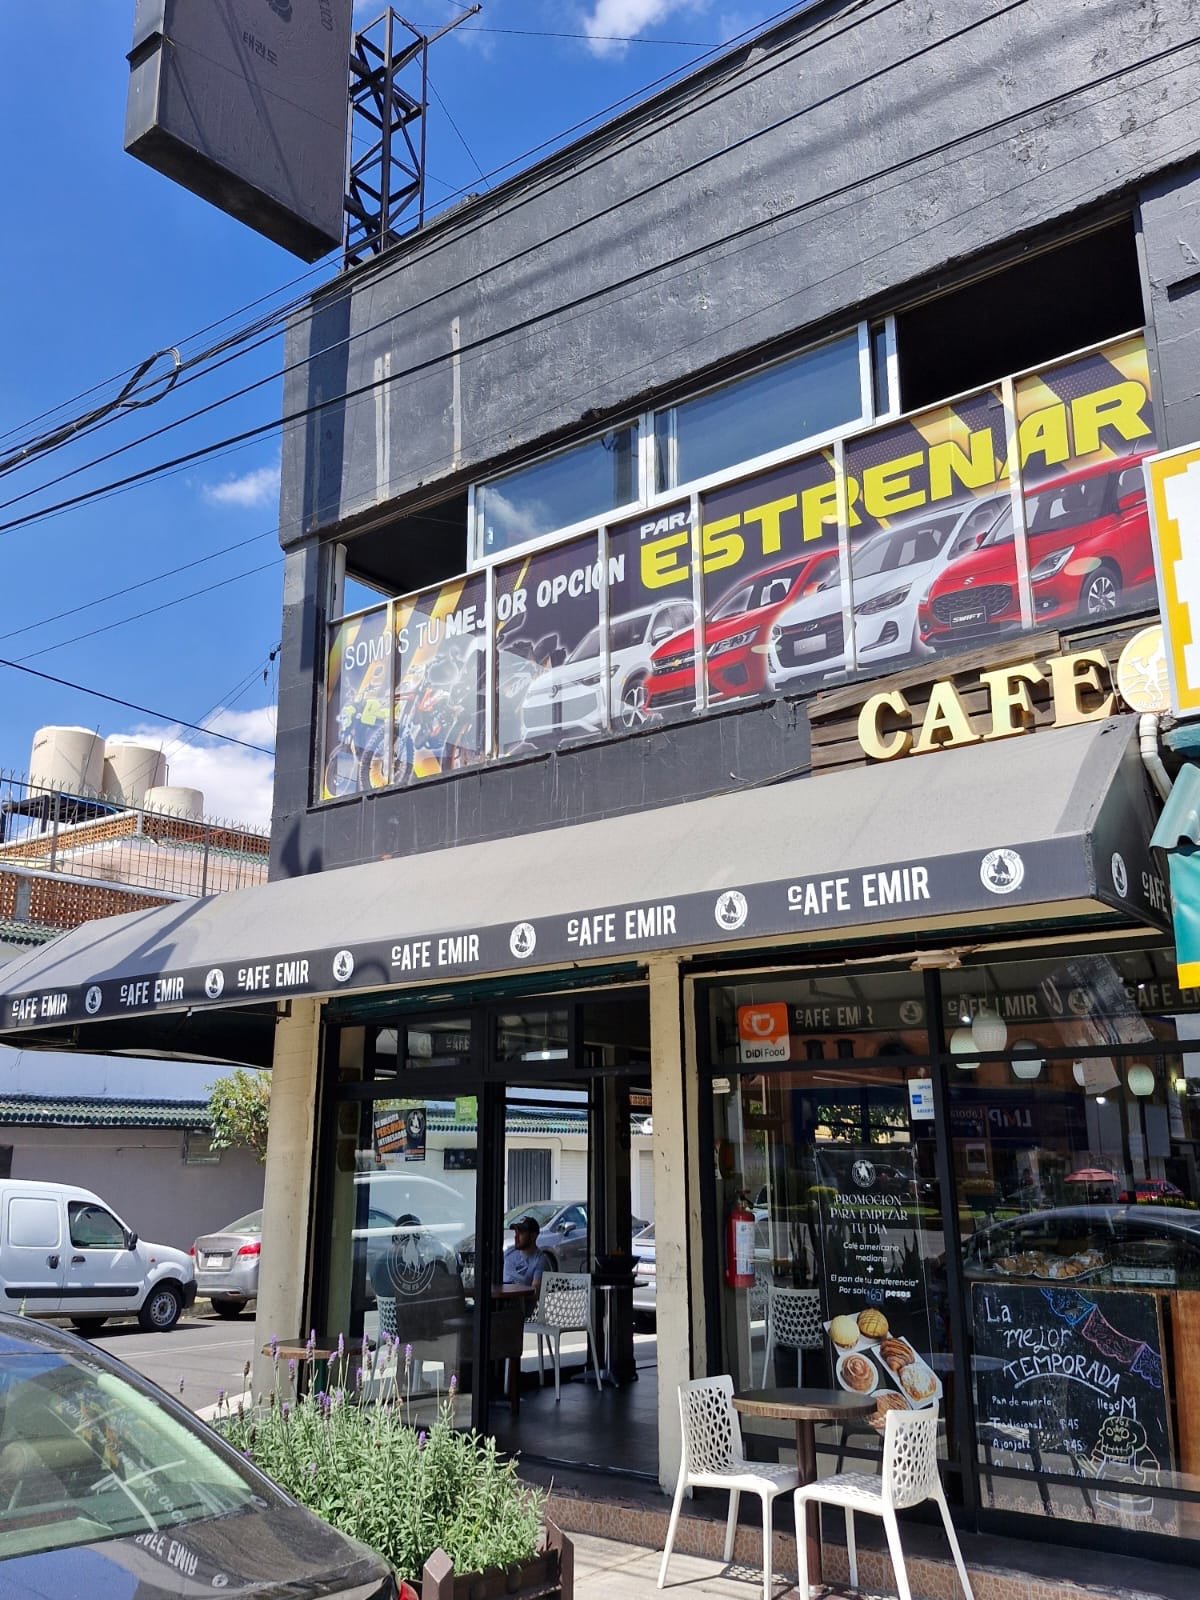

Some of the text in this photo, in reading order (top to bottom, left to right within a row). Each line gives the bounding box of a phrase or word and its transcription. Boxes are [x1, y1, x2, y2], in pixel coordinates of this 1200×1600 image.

[641, 380, 1152, 590] ESTRENAR
[344, 553, 625, 670] SOMOS TU MEJOR OPCIÓN
[951, 611, 984, 624] SWIFT
[857, 649, 1117, 760] CAFE
[787, 866, 931, 916] CAFE EMIR
[1142, 871, 1169, 914] CAFE
[567, 905, 677, 947] CAFE EMIR
[391, 934, 480, 971] CAFE EMIR
[237, 959, 309, 991] CAFE EMIR
[120, 976, 184, 1006] CAFE EMIR
[11, 993, 68, 1020] CAFE EMIR
[796, 1006, 874, 1028] CAFE EMIR
[765, 1047, 785, 1058] Food
[830, 1208, 908, 1221] PARA EMPEZAR
[851, 1223, 865, 1234] TU
[855, 1254, 888, 1263] mediano
[859, 1243, 900, 1252] americano
[830, 1274, 837, 1282] El
[838, 1276, 853, 1284] pan
[854, 1275, 864, 1283] de
[839, 1286, 851, 1294] Por
[885, 1290, 912, 1299] pesos
[984, 1297, 1011, 1324] La
[1003, 1326, 1072, 1353] mejor
[1003, 1354, 1121, 1393] TEMPORADA
[992, 1394, 1053, 1406] Pan de muerto
